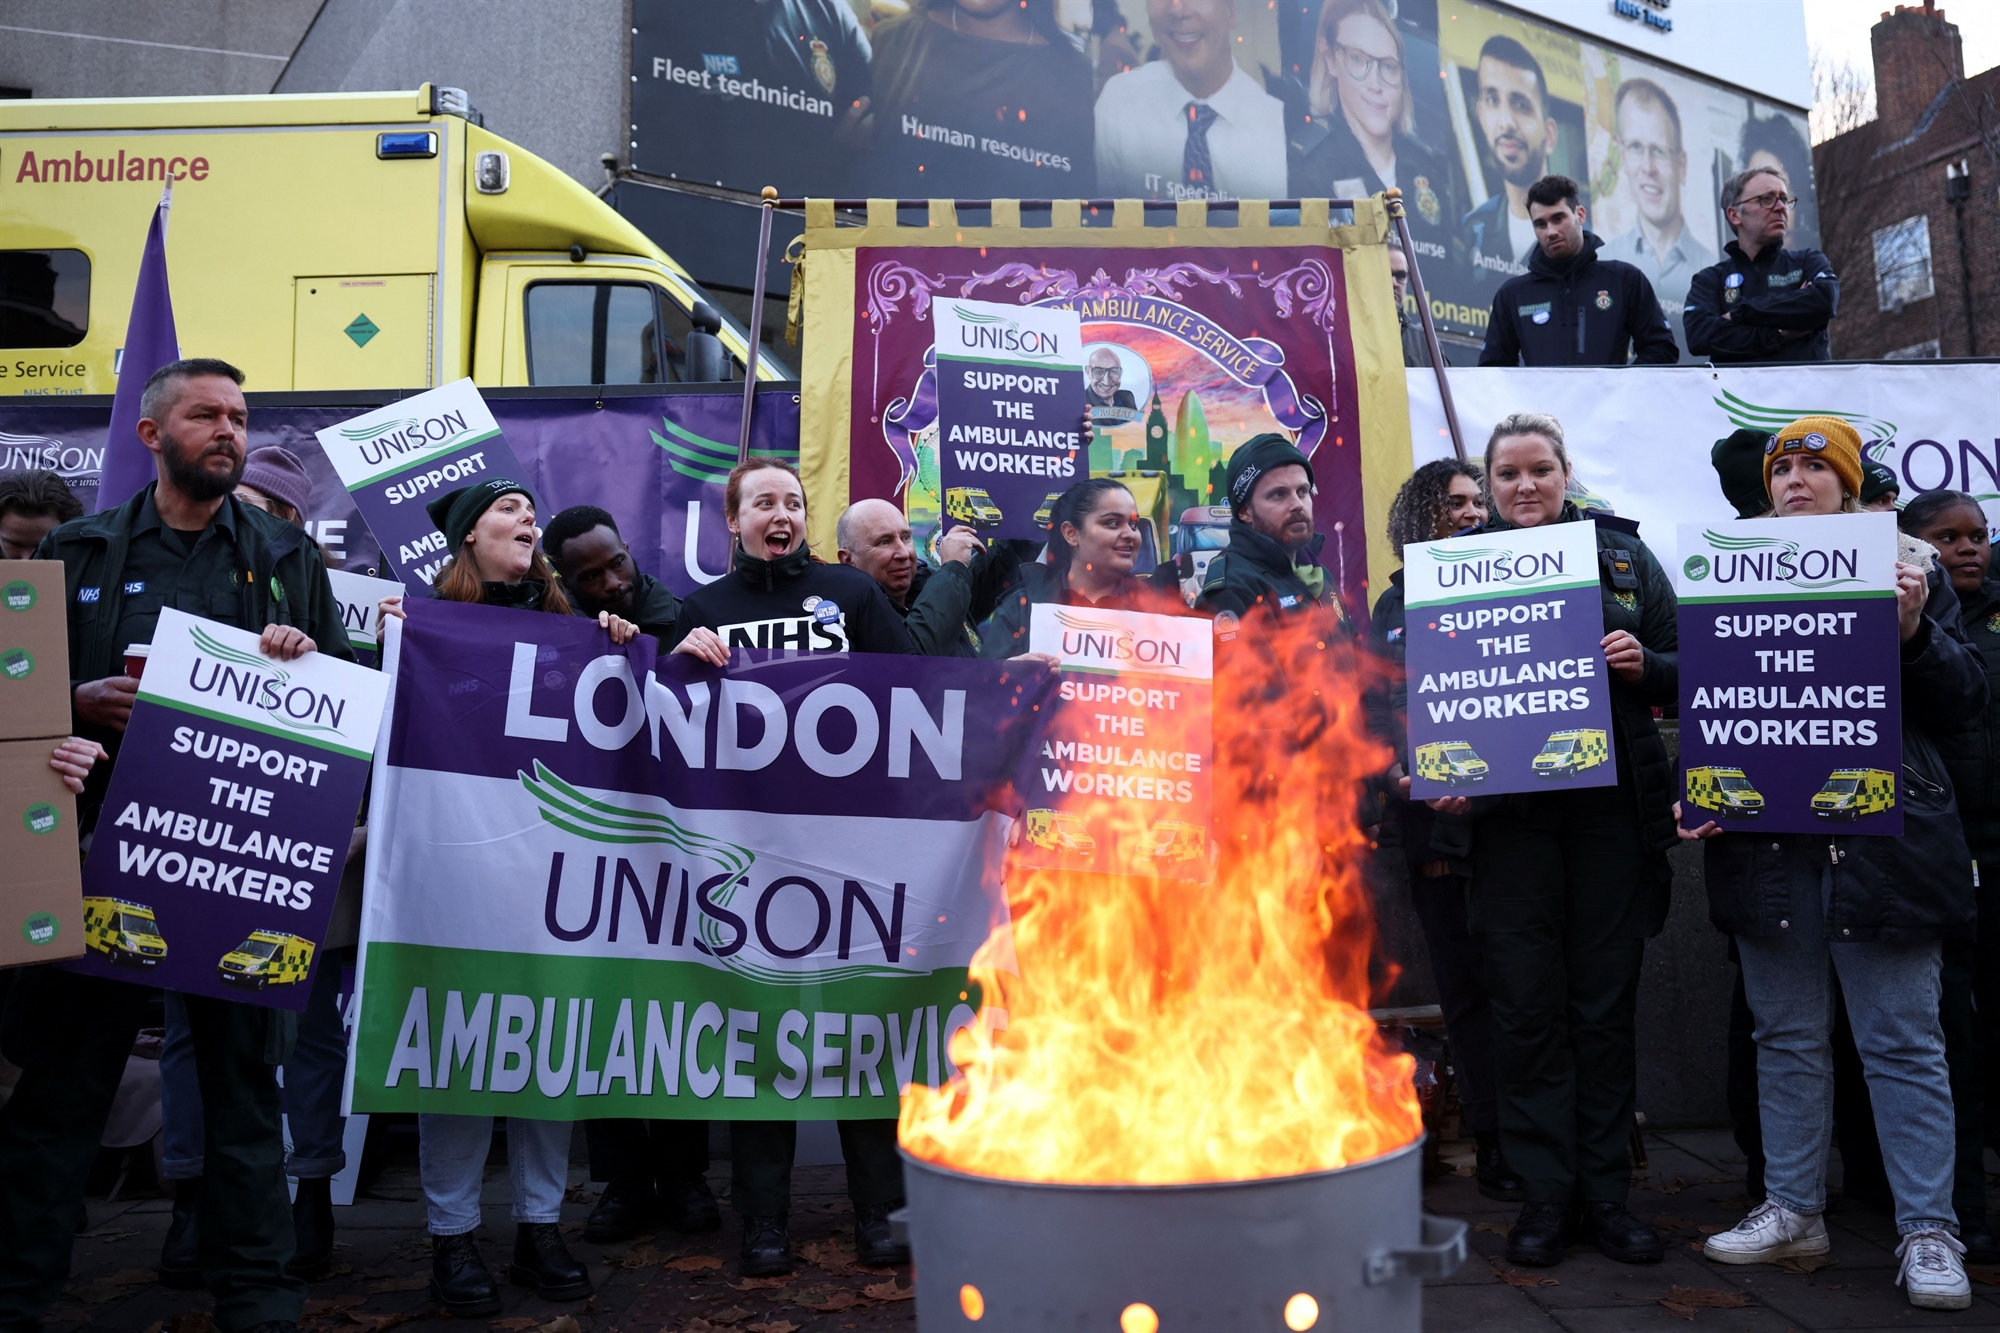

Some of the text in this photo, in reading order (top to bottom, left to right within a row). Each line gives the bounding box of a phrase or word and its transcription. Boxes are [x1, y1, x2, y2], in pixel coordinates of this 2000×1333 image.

[703, 55, 737, 74] NHS
[652, 57, 834, 118] Fleet technician
[902, 114, 1072, 172] Human resources
[15, 150, 210, 184] Ambulance
[1144, 172, 1162, 192] IT
[960, 323, 1059, 355] UNISON
[1080, 300, 1260, 379] AMBULANCE SERVICE
[15, 360, 86, 378] Service
[963, 370, 1060, 396] SUPPORT
[23, 387, 84, 396] NHS Trust
[992, 400, 1035, 421] THE
[358, 408, 469, 466] UNISON
[948, 424, 1081, 451] AMBULANCE
[384, 452, 487, 506] SUPPORT
[954, 450, 1076, 478] WORKERS
[79, 476, 101, 487] unio
[1438, 550, 1563, 588] UNISON
[1714, 549, 1858, 584] UNISON
[78, 587, 100, 602] NHS
[1281, 595, 1297, 608] NHS
[1438, 600, 1566, 633] SUPPORT
[1714, 612, 1858, 639] SUPPORT
[728, 618, 844, 661] NHS
[1062, 630, 1182, 665] UNISON
[1476, 633, 1531, 658] THE
[1417, 657, 1596, 694] AMBULANCE
[1755, 650, 1815, 673] THE
[189, 657, 346, 729] UNISON
[1059, 680, 1180, 711] SUPPORT
[1426, 687, 1590, 724] WORKERS
[1691, 685, 1887, 710] AMBULANCE
[503, 641, 967, 781] LONDON
[1094, 713, 1145, 738] THE
[1699, 719, 1879, 747] WORKERS
[170, 726, 328, 787] SUPPORT
[1040, 739, 1202, 773] AMBULANCE
[208, 776, 275, 818] THE
[1041, 767, 1193, 804] WORKERS
[114, 801, 334, 874] AMBULANCE
[118, 840, 314, 911] WORKERS
[544, 850, 907, 963] UNISON
[384, 986, 760, 1100] AMBULANCE
